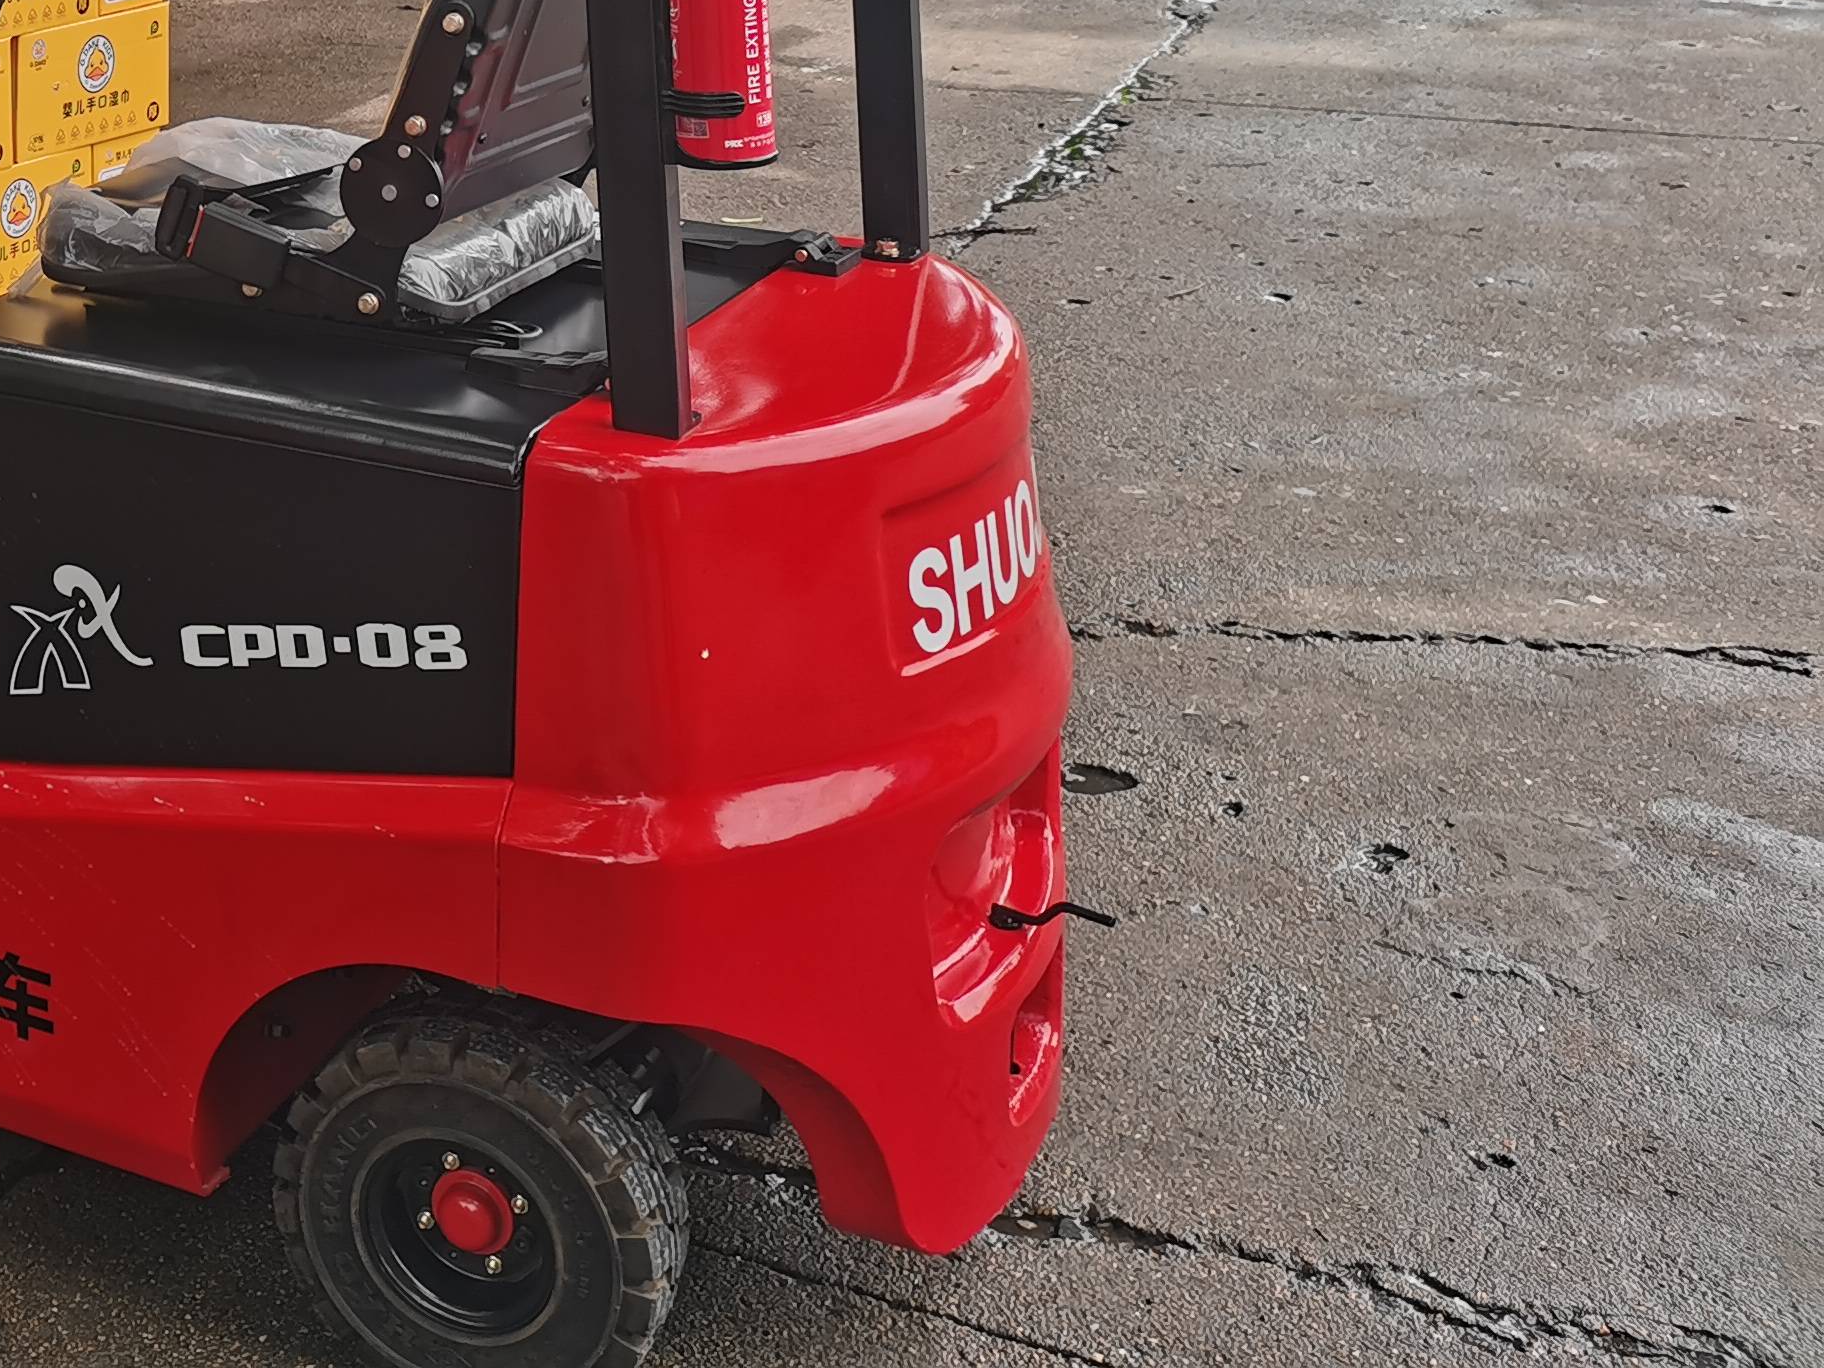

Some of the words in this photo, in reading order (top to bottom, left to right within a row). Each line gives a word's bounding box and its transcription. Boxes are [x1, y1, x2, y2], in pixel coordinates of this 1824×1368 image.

[62, 89, 130, 120] 婴儿手口湿巾
[746, 64, 762, 105] FIRE
[908, 455, 1042, 653] SHUO
